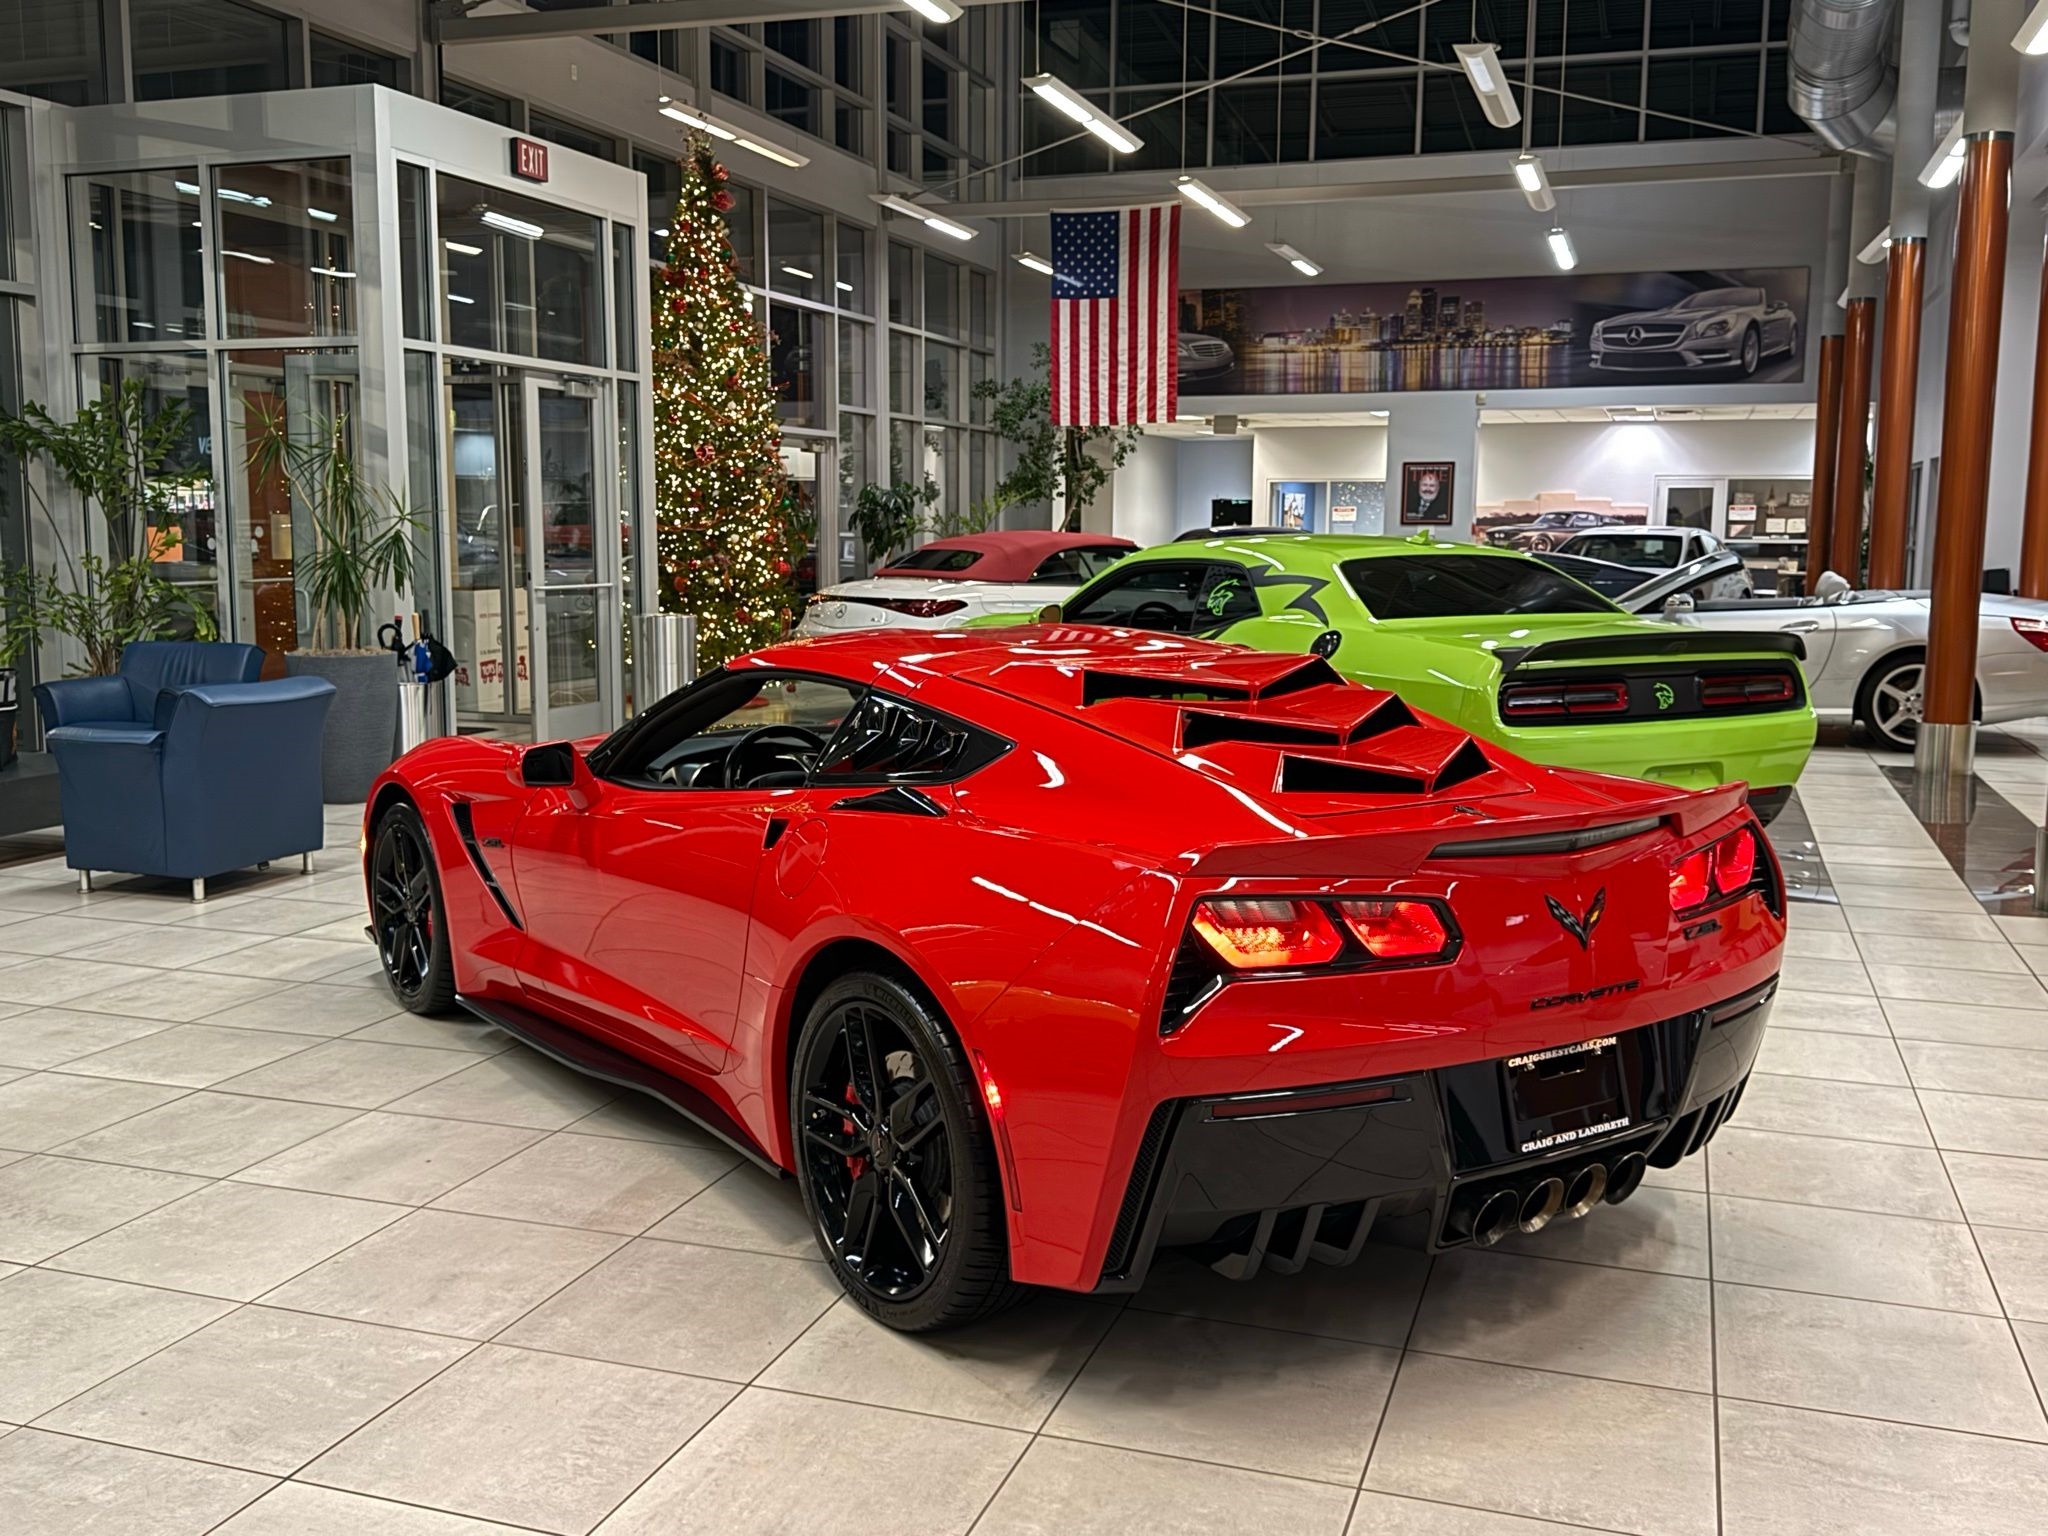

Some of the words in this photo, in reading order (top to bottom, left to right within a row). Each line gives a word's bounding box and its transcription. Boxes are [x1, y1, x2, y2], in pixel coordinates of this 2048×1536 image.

[521, 143, 544, 177] EXIT
[1530, 979, 1640, 1011] CORVETTE
[1508, 1036, 1617, 1067] CRAIGSBESTCARS.COM
[1521, 1137, 1554, 1152] CRAIG
[1555, 1131, 1577, 1144] AND
[1578, 1117, 1630, 1139] LANDRETH
